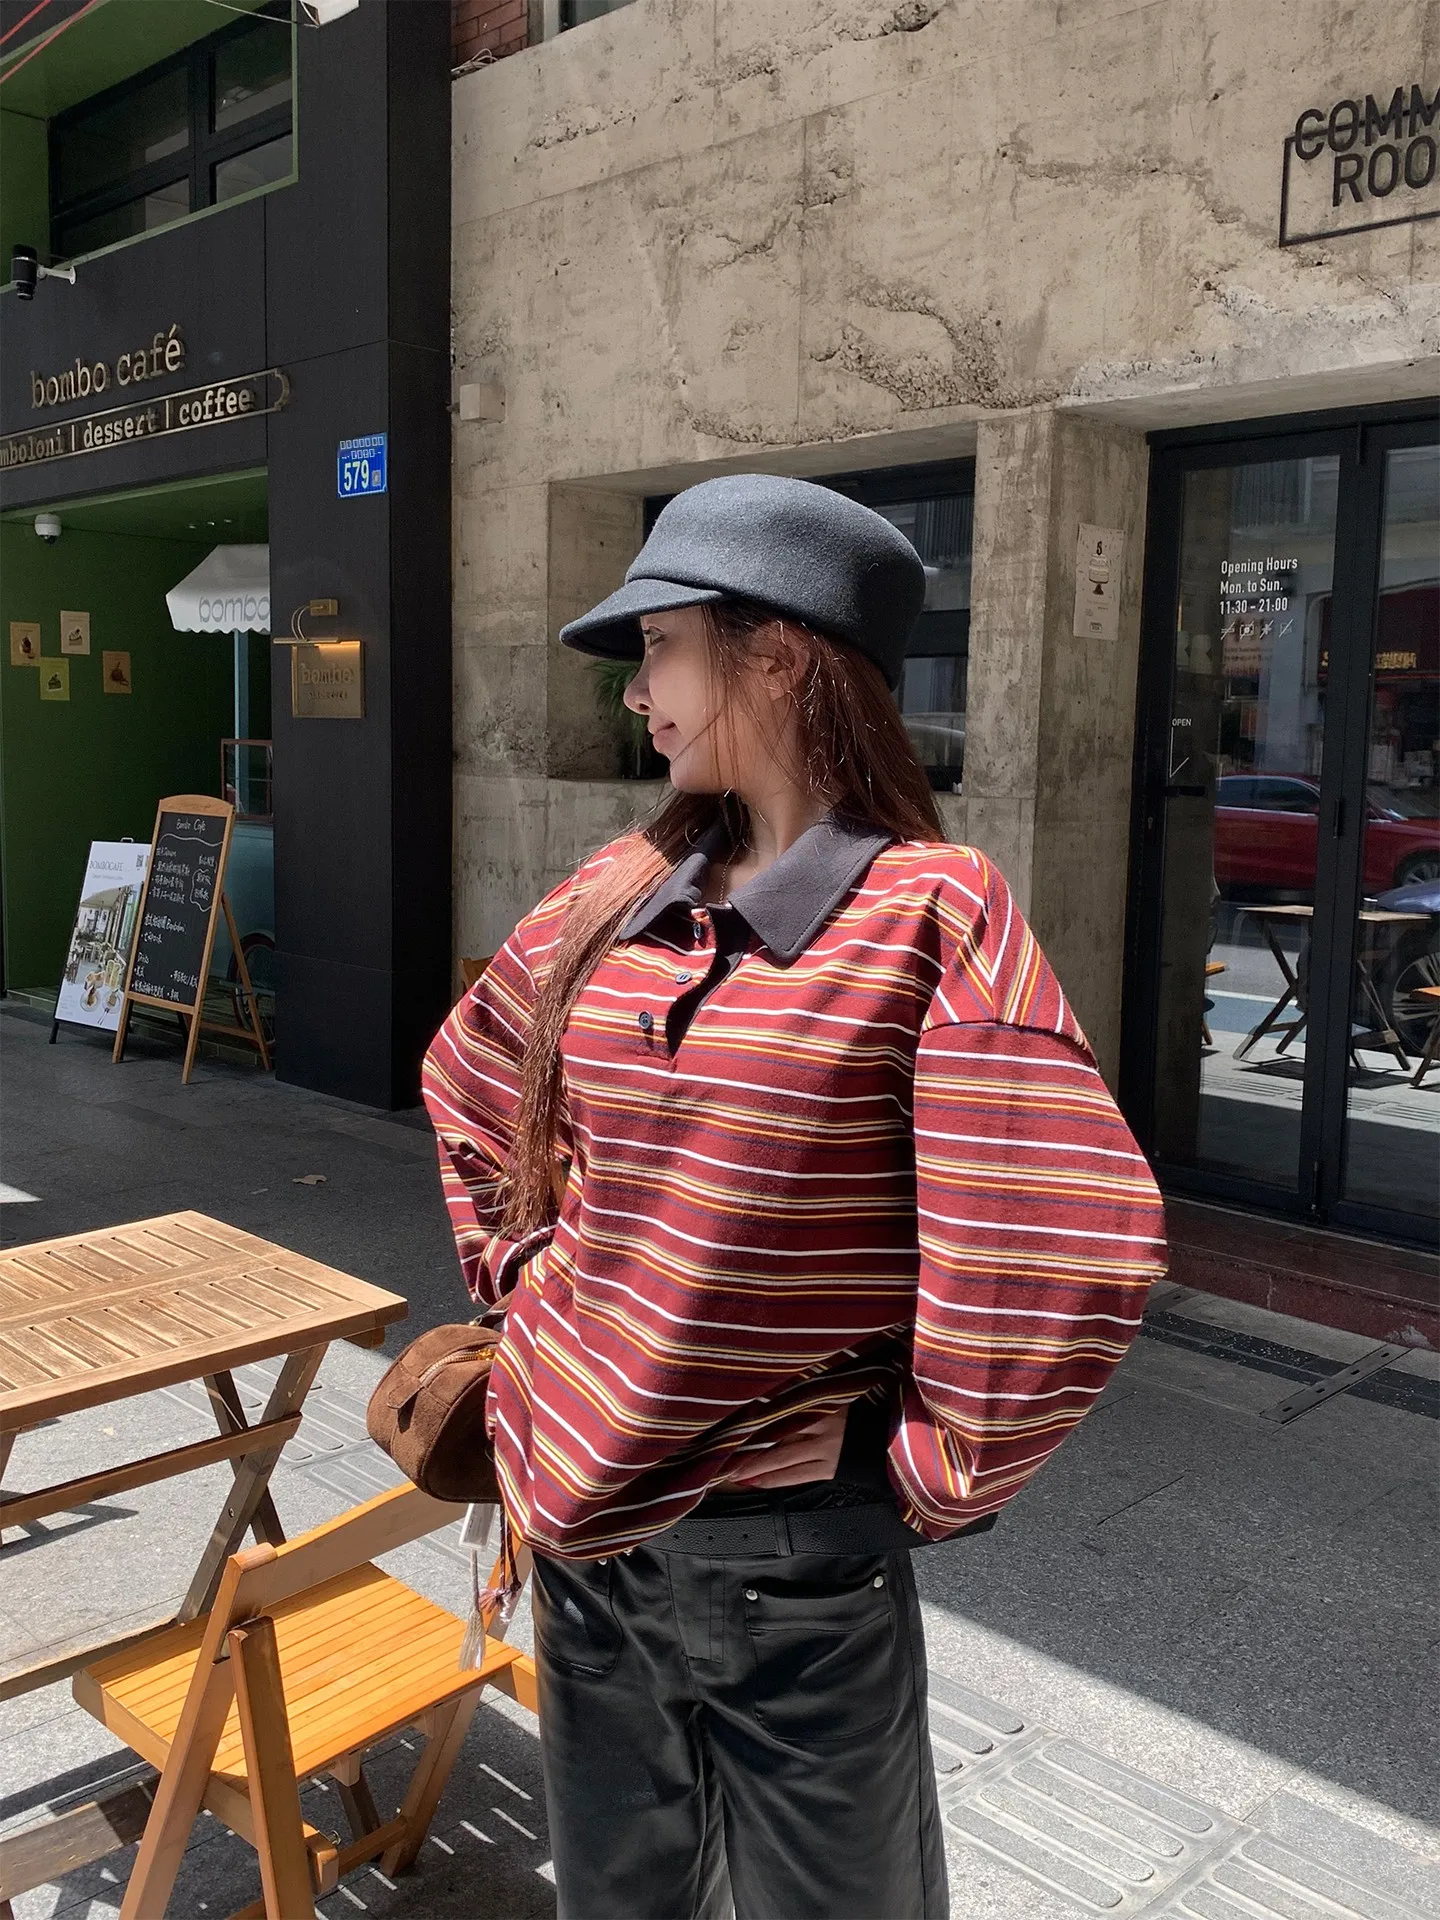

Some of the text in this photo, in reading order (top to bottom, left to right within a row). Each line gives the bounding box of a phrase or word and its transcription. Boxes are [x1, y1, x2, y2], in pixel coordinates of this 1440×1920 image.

[1332, 135, 1437, 207] ROO
[31, 323, 183, 408] bombo café
[84, 407, 156, 448] dessert
[179, 387, 251, 425] coffee
[343, 459, 370, 491] 579
[1221, 557, 1298, 577] Opening Hours
[1220, 578, 1284, 595] Mon. to Sun.
[199, 594, 270, 622] bombo
[1220, 599, 1248, 614] 11:30
[1258, 597, 1288, 612] 21:00
[1172, 718, 1192, 727] OPEN
